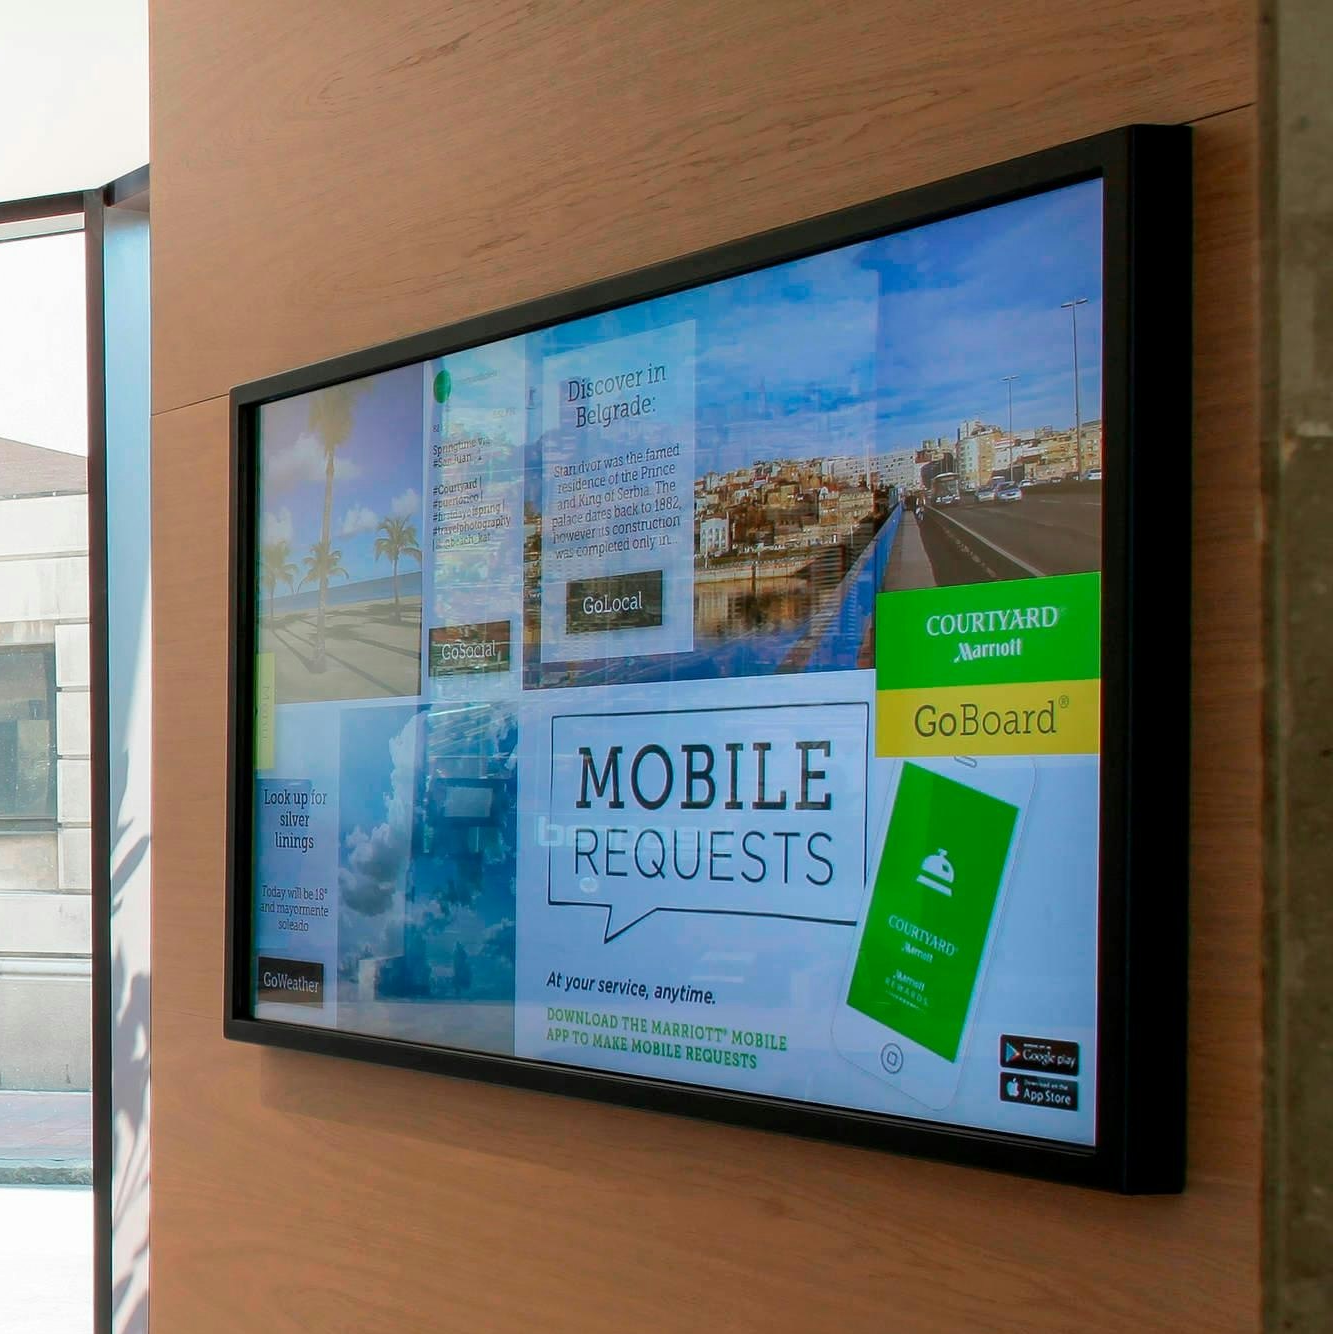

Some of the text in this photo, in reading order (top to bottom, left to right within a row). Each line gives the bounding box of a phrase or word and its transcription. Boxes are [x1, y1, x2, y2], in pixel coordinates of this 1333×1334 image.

[568, 363, 666, 402] Discover in
[576, 394, 656, 428] Belgrade:
[578, 458, 601, 473] dvor
[603, 456, 623, 469] was
[626, 448, 643, 464] the
[645, 443, 680, 461] famed
[432, 478, 477, 495] #Courtyard
[557, 463, 675, 494] residence of the Prince
[557, 496, 576, 511] and
[578, 492, 602, 510] King
[604, 489, 615, 504] of
[655, 480, 676, 494] The
[551, 496, 682, 531] palace dates back to 1882,
[552, 515, 681, 545] however its construction
[555, 547, 574, 560] was
[577, 538, 630, 557] completed
[632, 534, 656, 551] only
[583, 591, 643, 615] GoLocal
[926, 606, 1059, 636] COURTYARD
[441, 640, 496, 660] GoSocial
[953, 637, 1023, 664] Marriott
[575, 740, 832, 811] MOBILE
[264, 789, 327, 809] Look up for
[280, 810, 310, 827] silver
[275, 831, 315, 853] linings
[574, 828, 833, 886] REQUESTS
[261, 885, 286, 898] Today
[288, 887, 301, 899] will
[303, 887, 314, 900] be
[260, 902, 329, 917] and mayormente
[278, 919, 309, 932] soleado
[888, 914, 955, 956] COURTYARD
[263, 971, 319, 993] GoWeather
[546, 971, 716, 1005] At your service, anytime.
[547, 1007, 618, 1029] DOWNLOAD
[621, 1015, 648, 1033] THE
[732, 1030, 787, 1051] MOBILE
[546, 1027, 757, 1069] APP TO MAKE MOBILE REQUESTS
[1022, 1049, 1076, 1068] Google play
[1023, 1088, 1071, 1105] App Store
